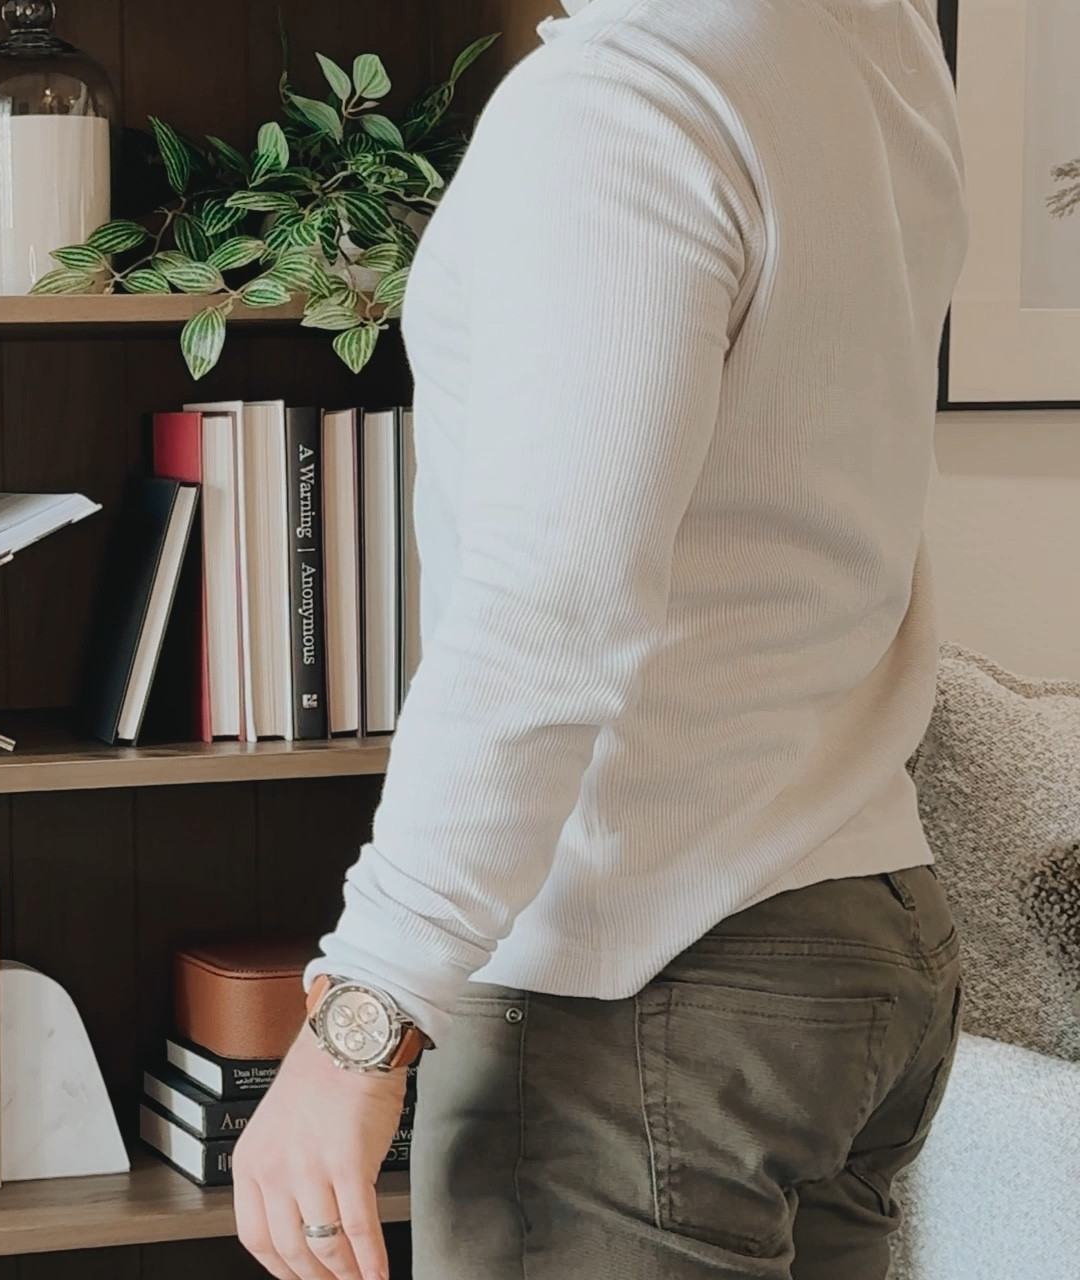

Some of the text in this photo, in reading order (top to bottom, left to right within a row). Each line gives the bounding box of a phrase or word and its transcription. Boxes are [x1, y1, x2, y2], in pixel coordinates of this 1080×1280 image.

[297, 444, 316, 665] A Warning Anonymous
